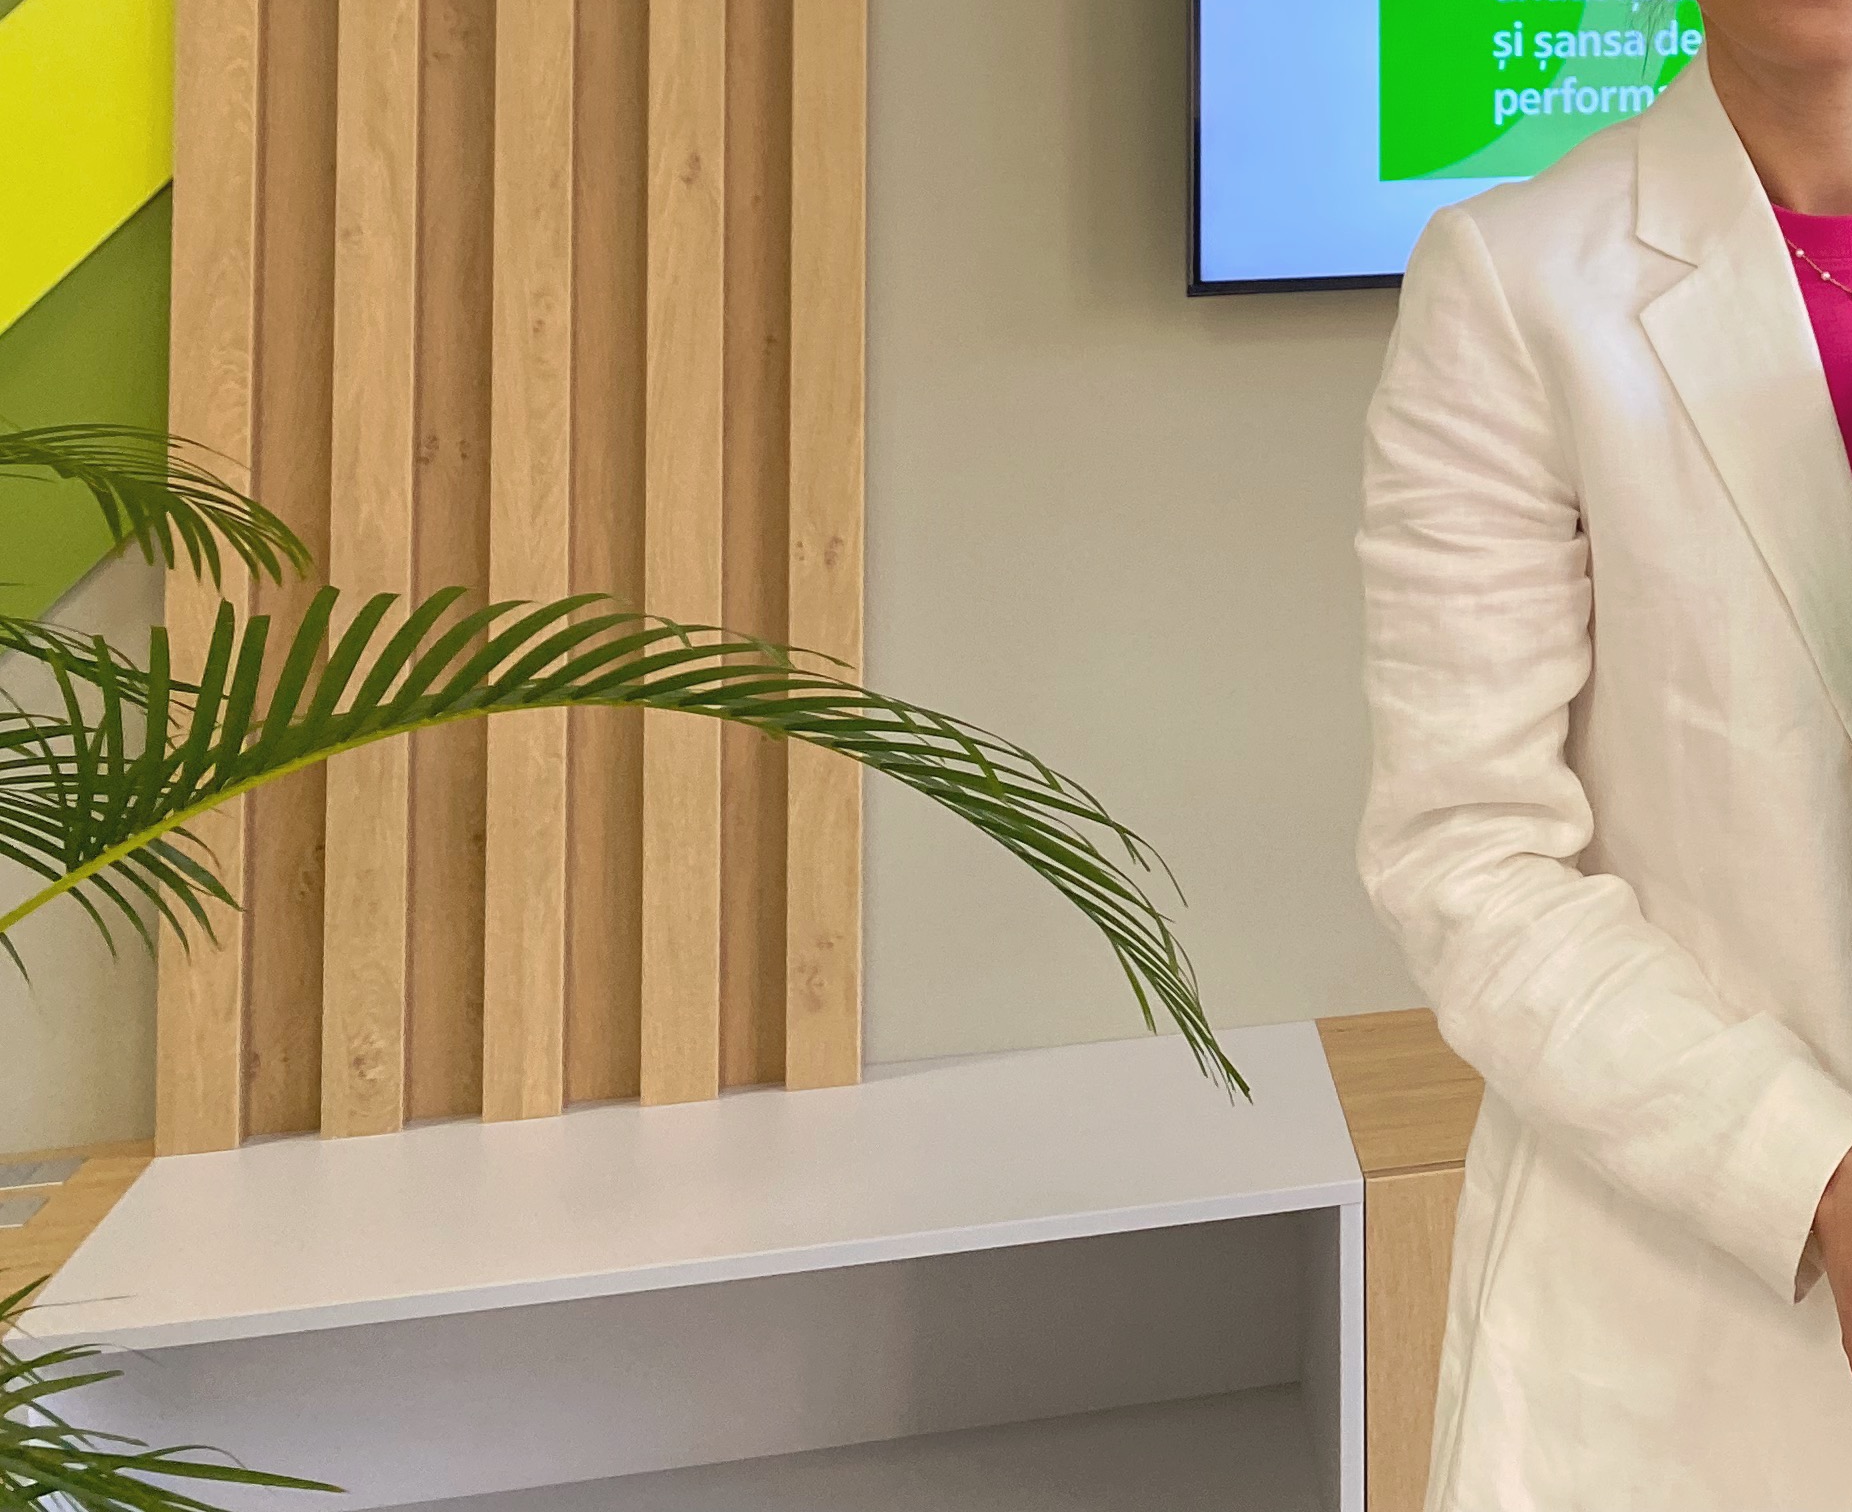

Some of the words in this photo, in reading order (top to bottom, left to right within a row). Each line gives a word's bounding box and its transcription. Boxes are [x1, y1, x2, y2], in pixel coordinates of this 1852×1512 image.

[1493, 20, 1524, 71] și
[1534, 29, 1647, 71] șansa
[1654, 20, 1703, 57] de
[1494, 76, 1669, 125] perform
